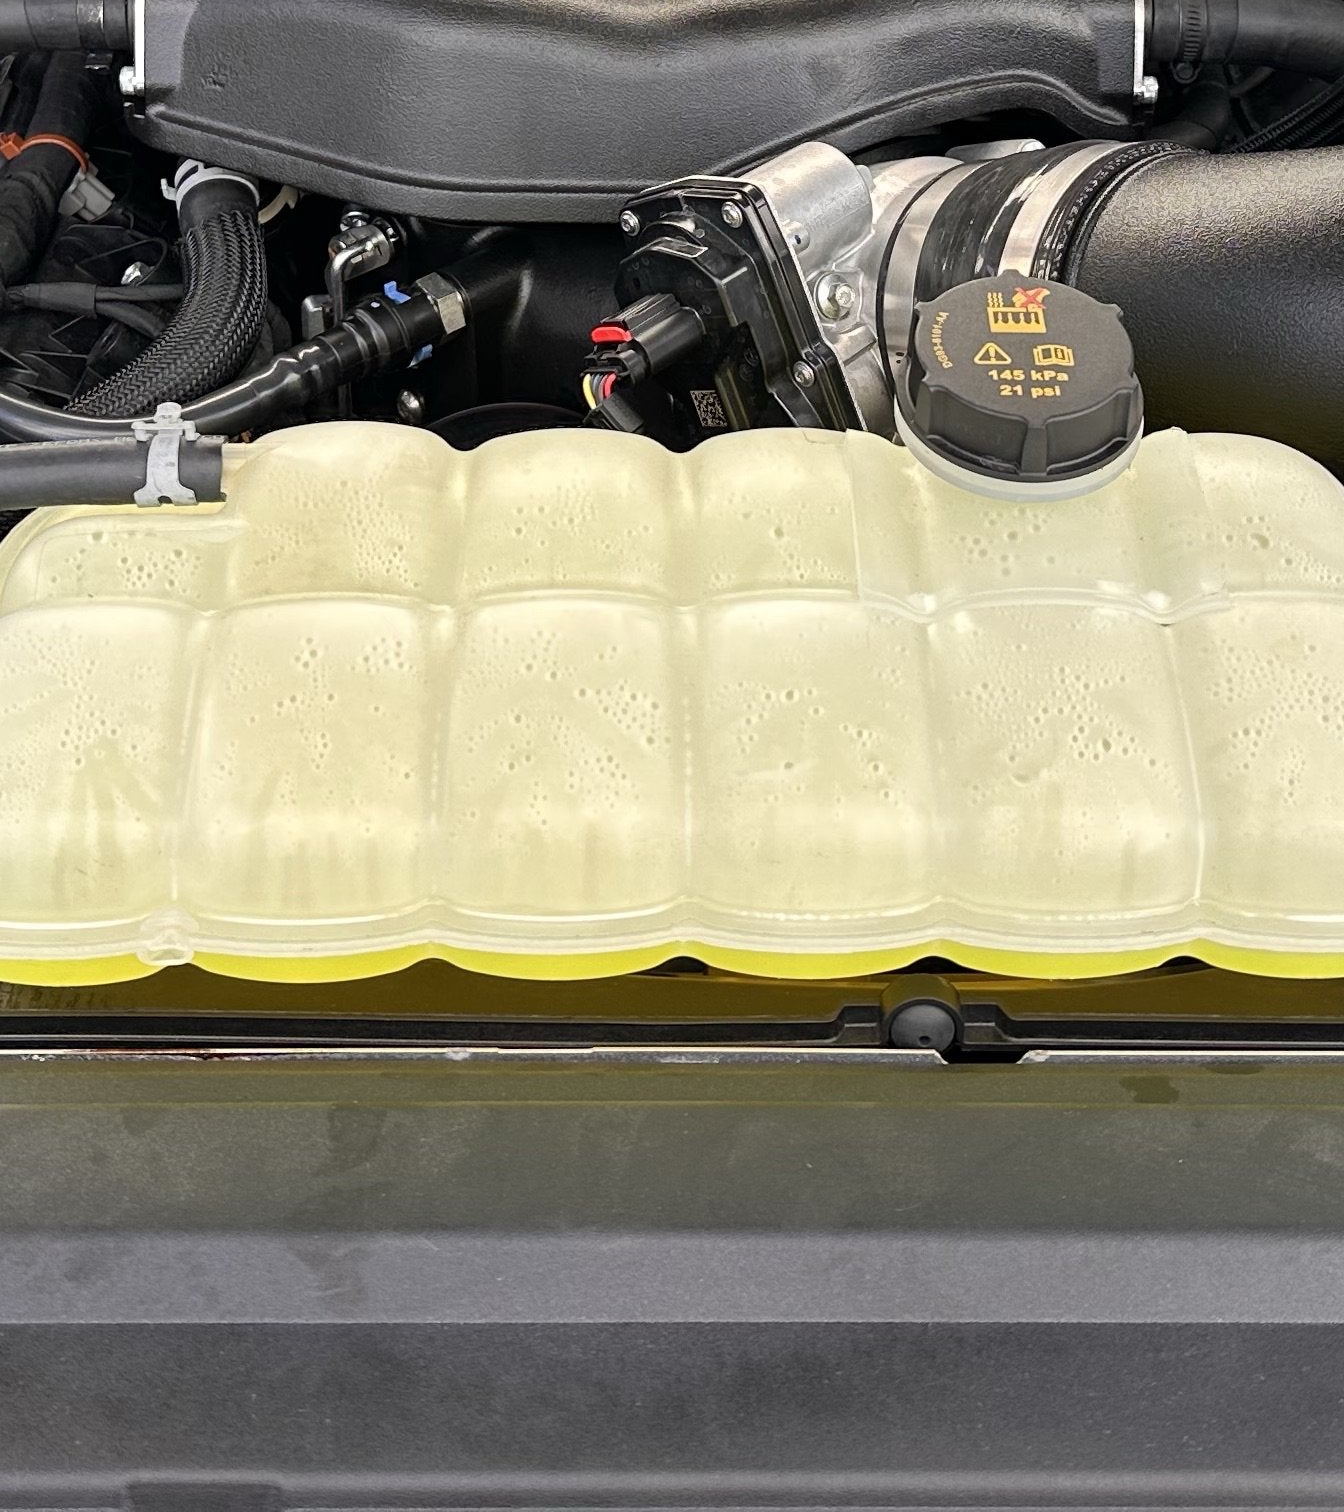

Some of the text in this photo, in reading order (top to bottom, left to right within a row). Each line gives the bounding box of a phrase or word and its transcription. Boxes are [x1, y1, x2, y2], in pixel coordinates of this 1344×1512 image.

[987, 369, 1070, 382] 145 kPa
[999, 384, 1062, 399] 21 psi
